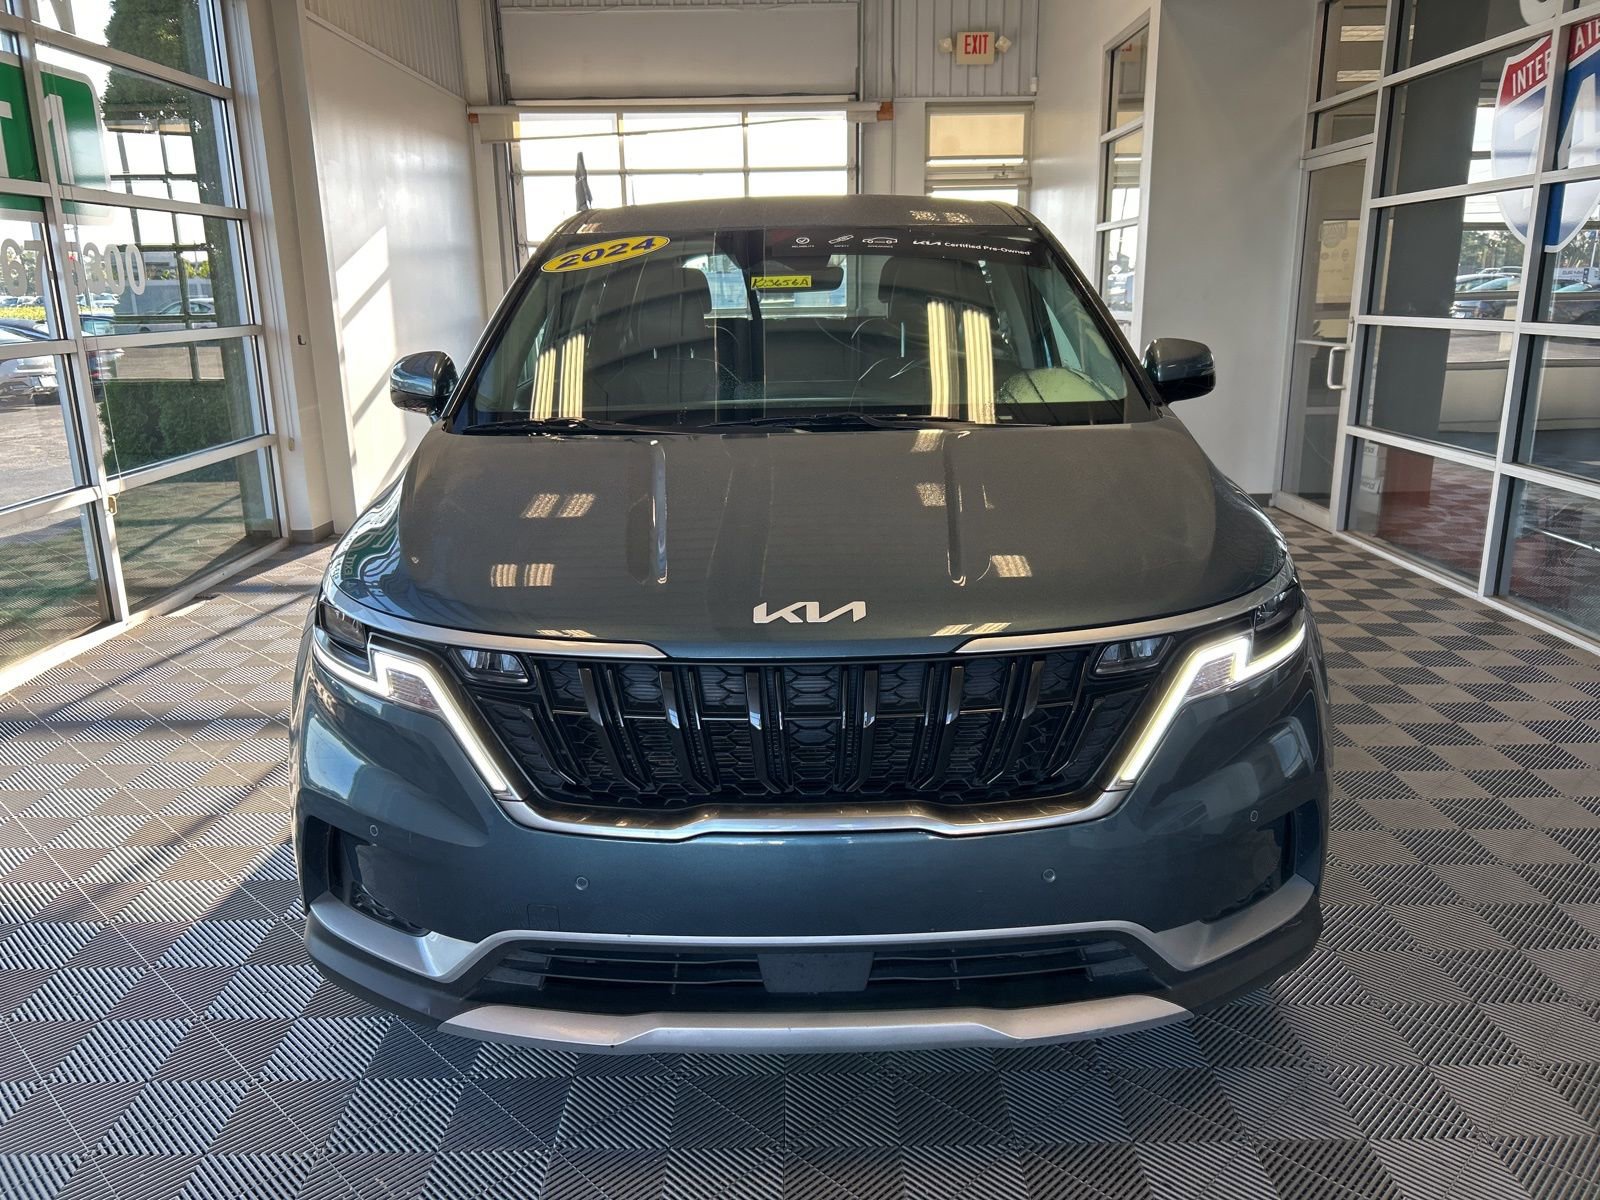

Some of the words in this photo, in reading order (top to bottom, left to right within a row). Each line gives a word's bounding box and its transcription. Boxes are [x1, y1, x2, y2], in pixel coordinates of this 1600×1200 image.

[964, 34, 989, 55] EXIT
[556, 236, 656, 270] 2024
[944, 242, 982, 250] Certified
[983, 245, 1031, 256] Pre-Owned
[752, 600, 867, 624] KIA
